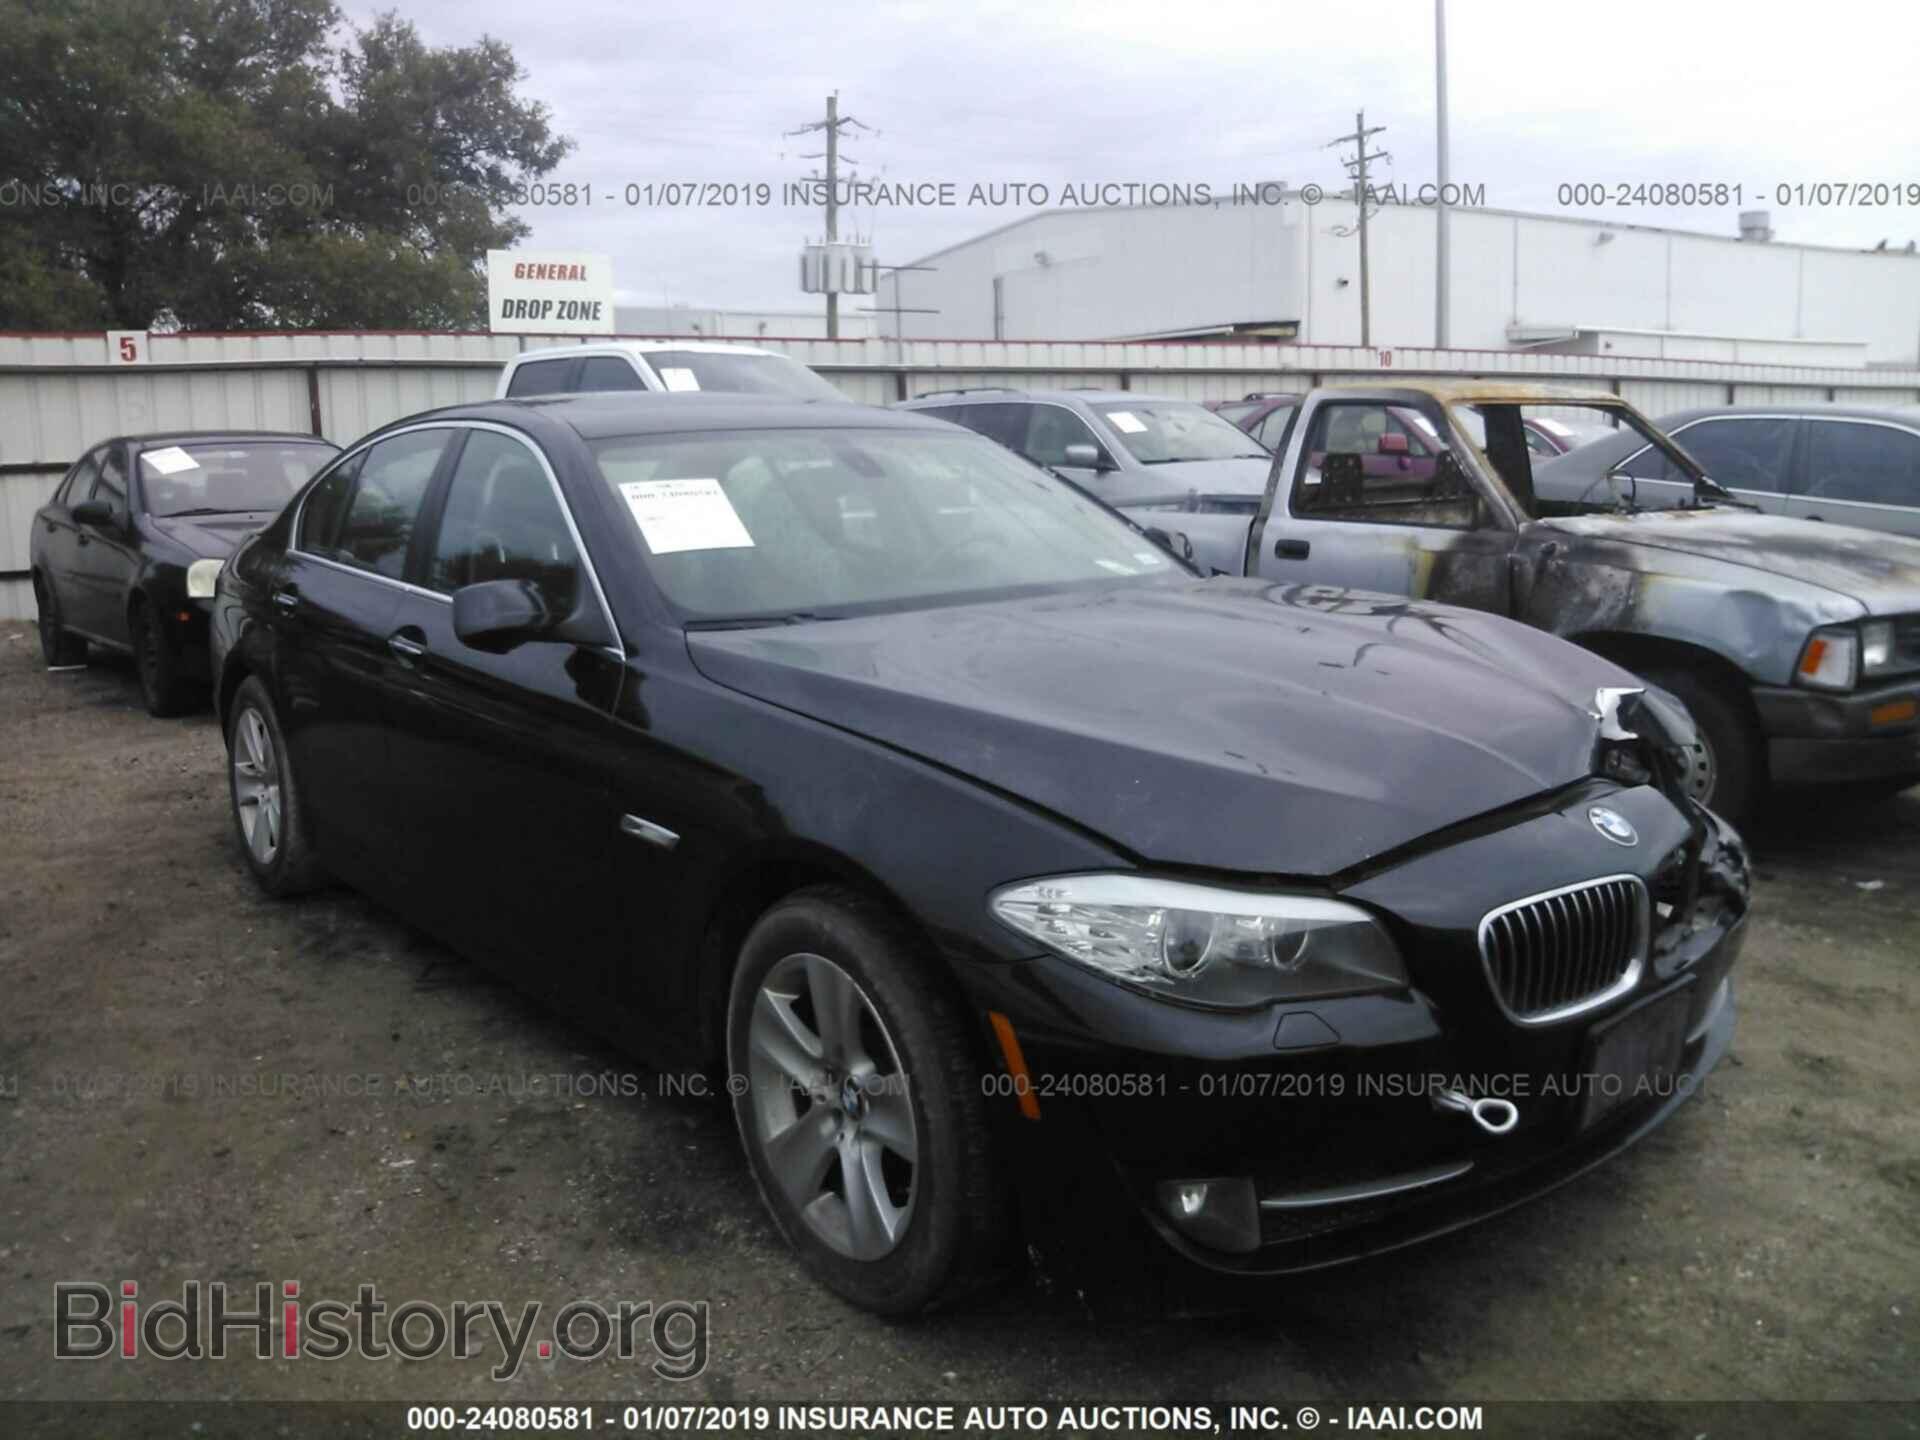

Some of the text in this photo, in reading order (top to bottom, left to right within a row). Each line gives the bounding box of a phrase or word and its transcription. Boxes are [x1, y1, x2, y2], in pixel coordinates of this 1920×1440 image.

[514, 263, 587, 281] GENERAL
[502, 298, 602, 321] DROP ZONE
[120, 336, 137, 362] 5
[1379, 350, 1392, 367] 10
